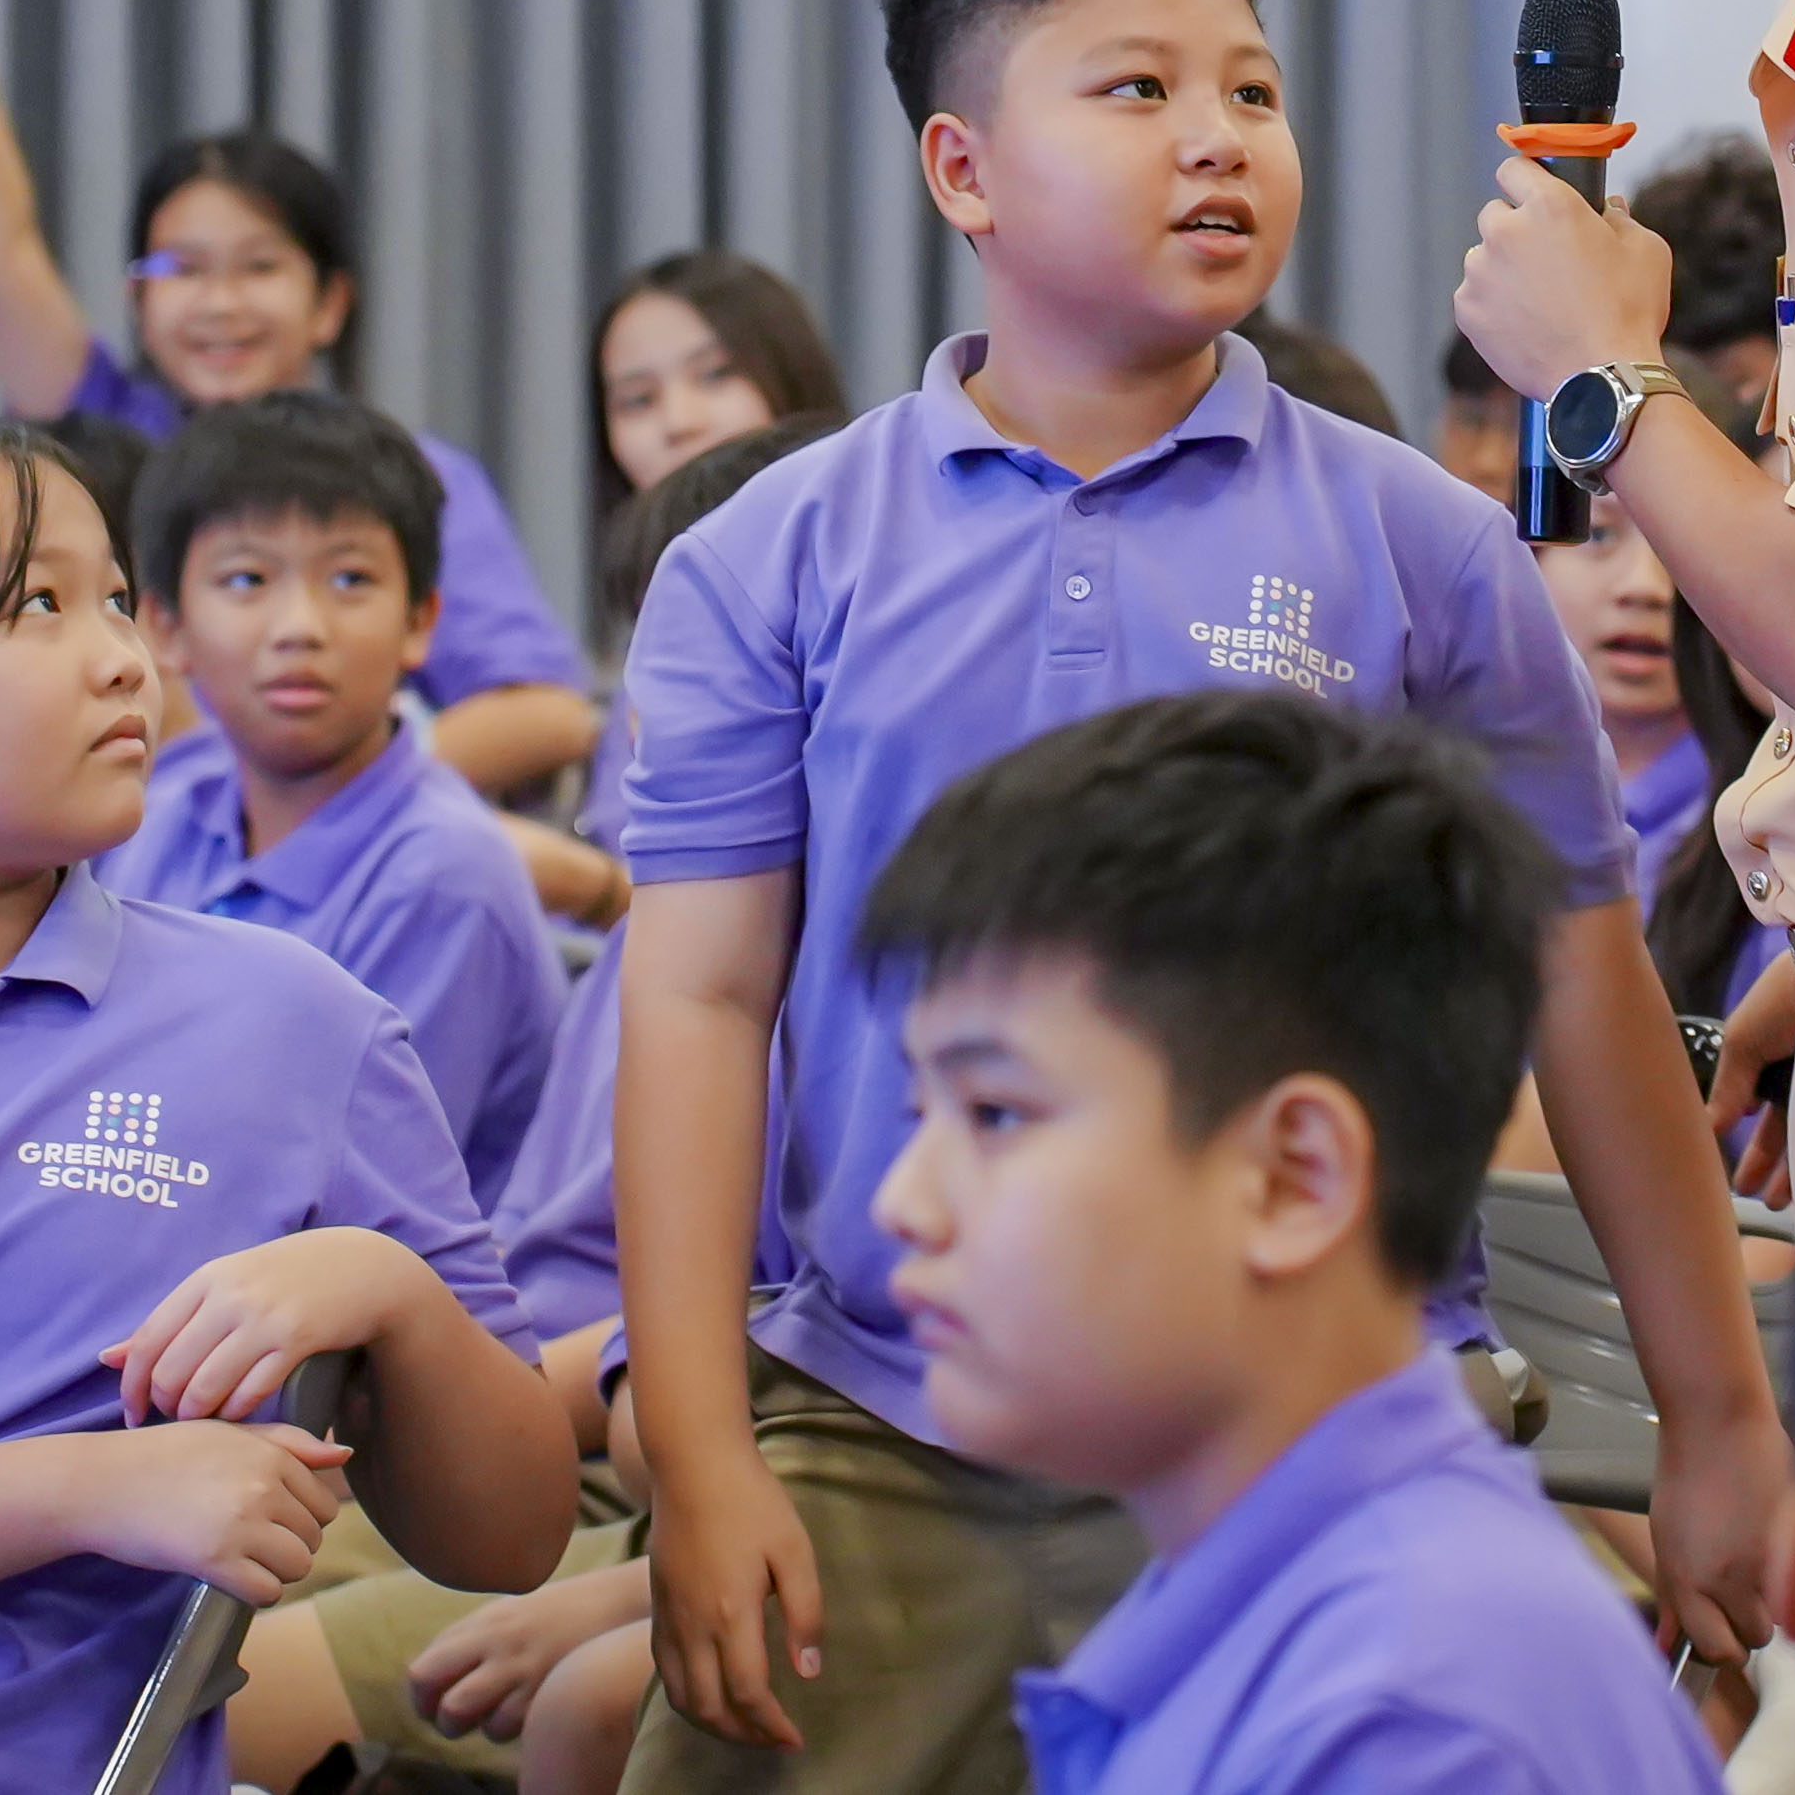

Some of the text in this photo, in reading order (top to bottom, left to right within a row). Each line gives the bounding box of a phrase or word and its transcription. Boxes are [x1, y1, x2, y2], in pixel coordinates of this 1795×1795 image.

[1189, 621, 1355, 682] GREENFIELD
[1208, 647, 1328, 699] SCHOOL
[17, 1141, 209, 1186] GREENFIELD
[38, 1166, 179, 1208] SCHOOL
